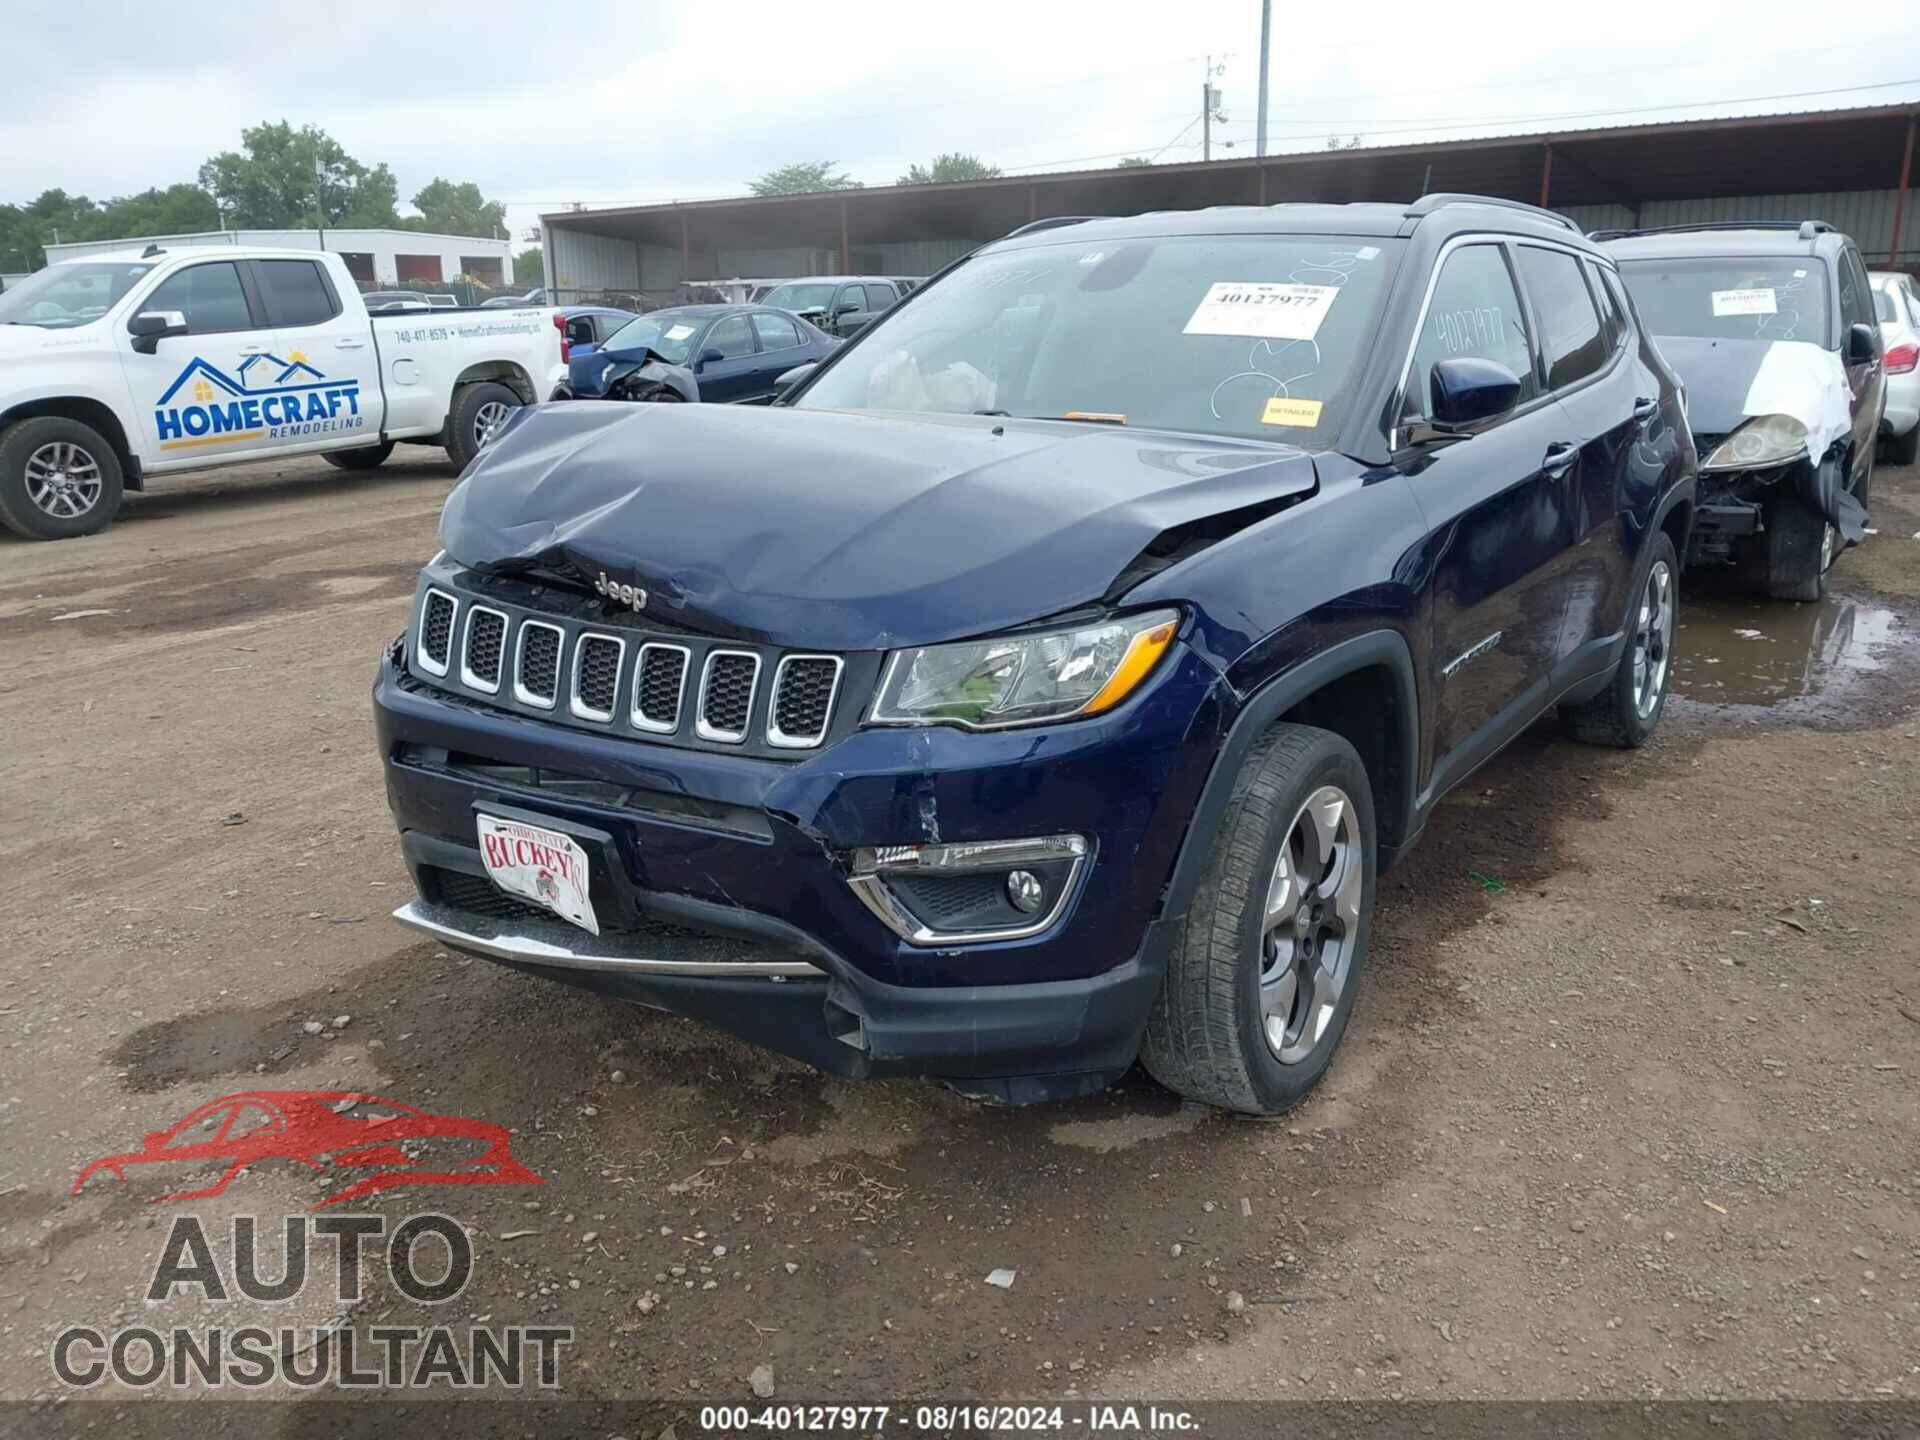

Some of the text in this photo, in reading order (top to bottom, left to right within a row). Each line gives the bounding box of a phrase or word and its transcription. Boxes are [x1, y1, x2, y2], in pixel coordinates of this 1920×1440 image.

[1215, 293, 1319, 307] 40127977
[154, 387, 360, 441] HOMECRAFT
[269, 416, 364, 439] REMODELING
[594, 570, 648, 613] Jeep
